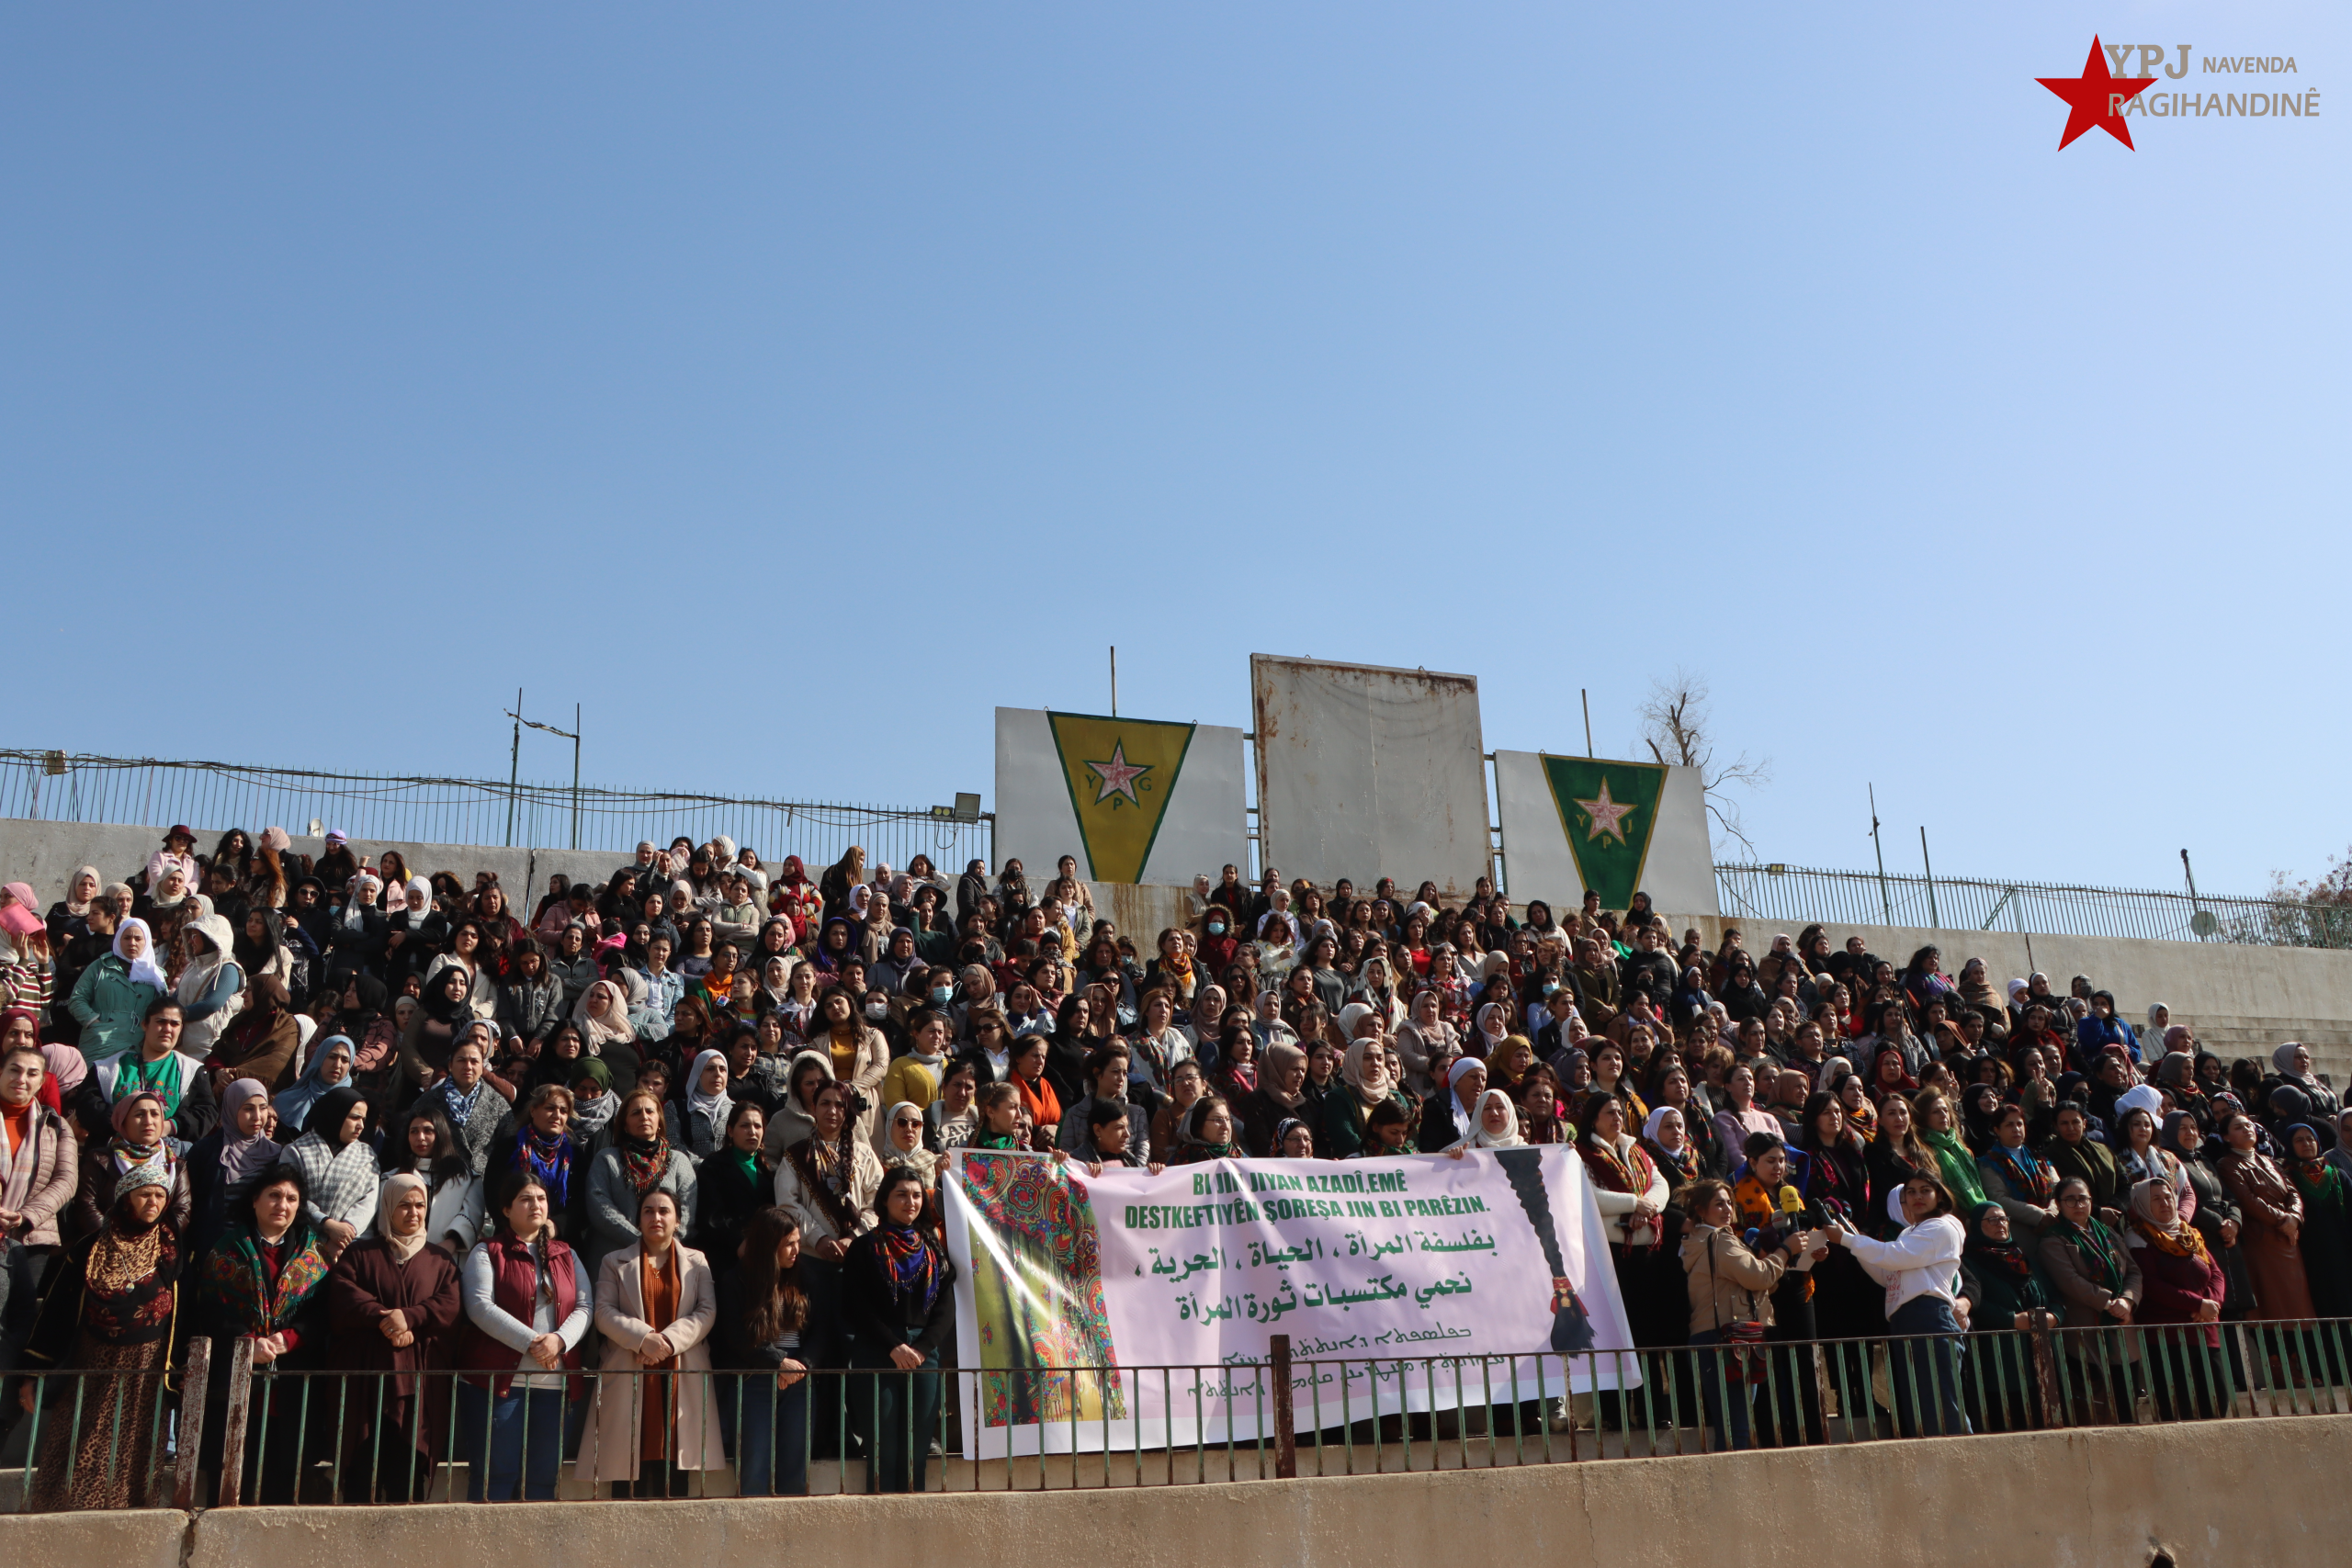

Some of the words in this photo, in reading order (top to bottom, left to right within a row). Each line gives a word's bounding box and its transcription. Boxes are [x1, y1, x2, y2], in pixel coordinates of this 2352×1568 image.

[1193, 1173, 1212, 1195] BI
[1216, 1172, 1245, 1194] JIN
[1250, 1172, 1304, 1191] JIYAN
[1125, 1198, 1260, 1229] DESTKEFTIYÊN
[1262, 1198, 1344, 1225] ŞOREŞA
[1346, 1201, 1377, 1217] JIN
[1378, 1200, 1403, 1217] BI
[1403, 1194, 1491, 1217] PARÊZIN.
[1413, 1229, 1498, 1257] بفلسفة
[1243, 1279, 1297, 1324] ثورة
[1304, 1273, 1408, 1312] مكتسبات
[1415, 1270, 1472, 1309] نحمي
[1174, 1291, 1242, 1326] المرأة
